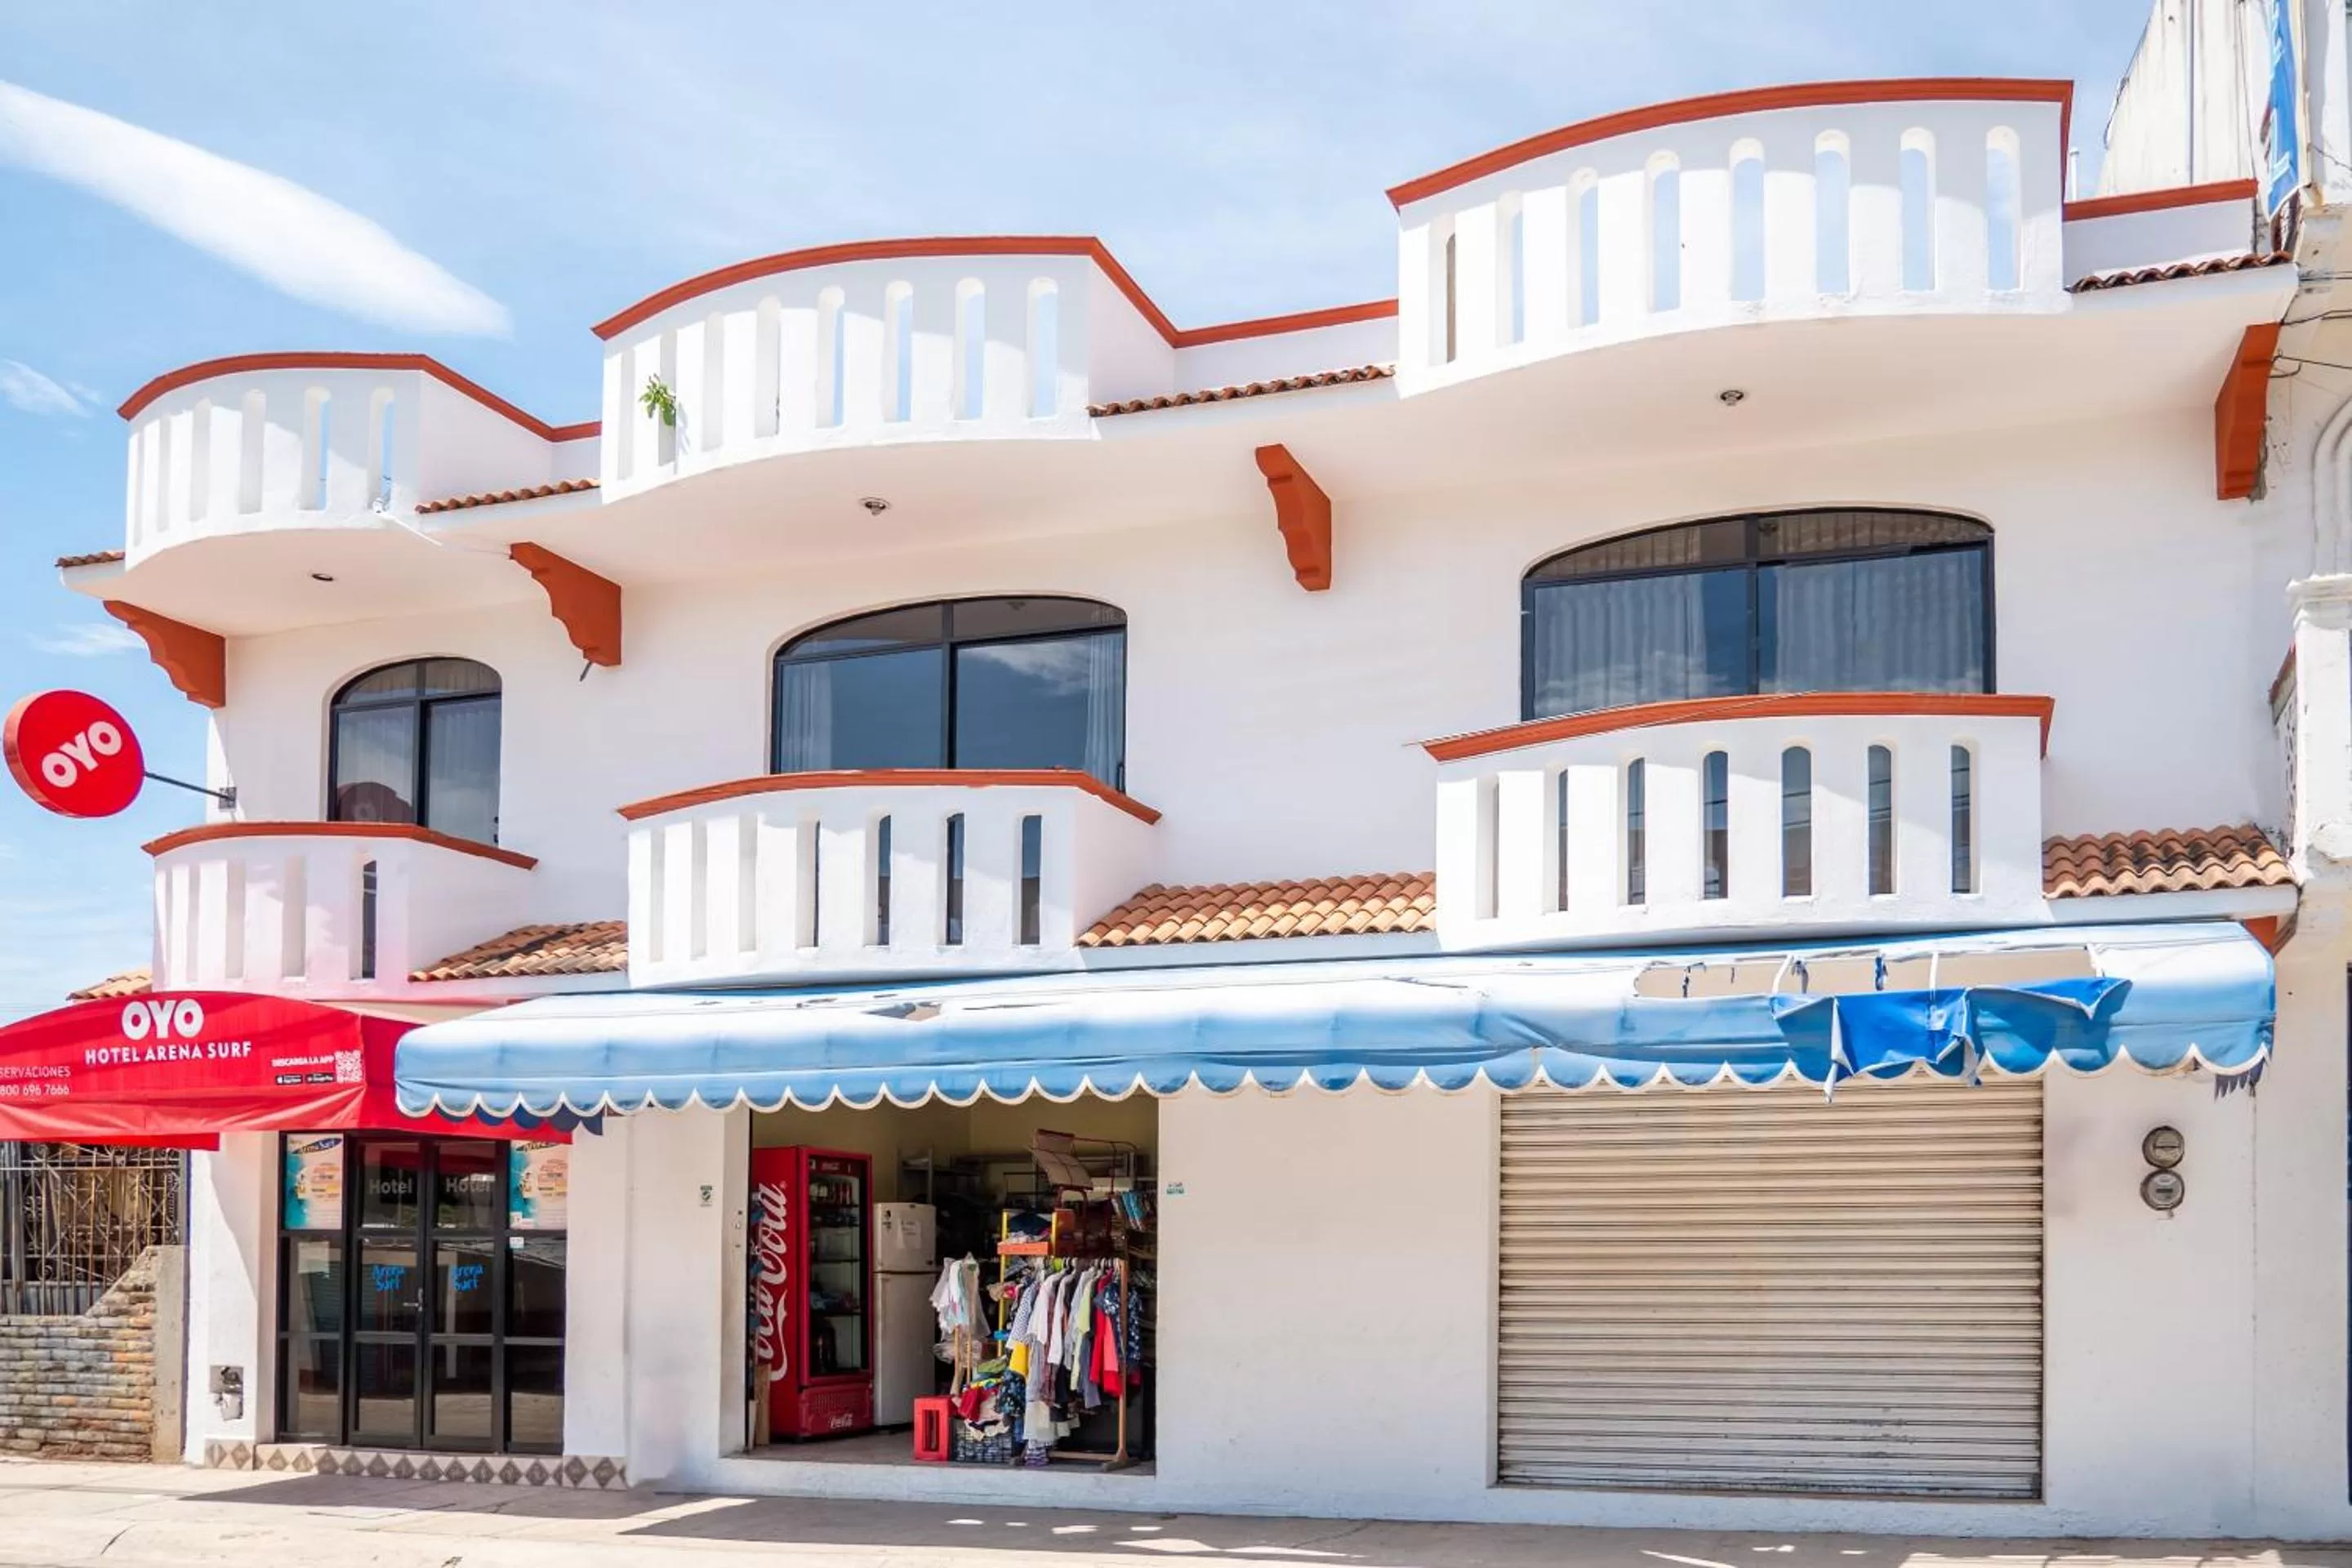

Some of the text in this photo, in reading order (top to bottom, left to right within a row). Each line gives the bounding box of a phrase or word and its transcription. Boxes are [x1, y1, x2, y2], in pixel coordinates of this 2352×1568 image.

[42, 720, 122, 788] OYO
[122, 998, 204, 1040] OYO
[85, 1040, 252, 1066] HOTEL ARENA SURF
[23, 1083, 42, 1096] 696
[44, 1083, 69, 1096] 7666
[368, 1178, 413, 1195] Hotel
[446, 1177, 491, 1192] Hotel
